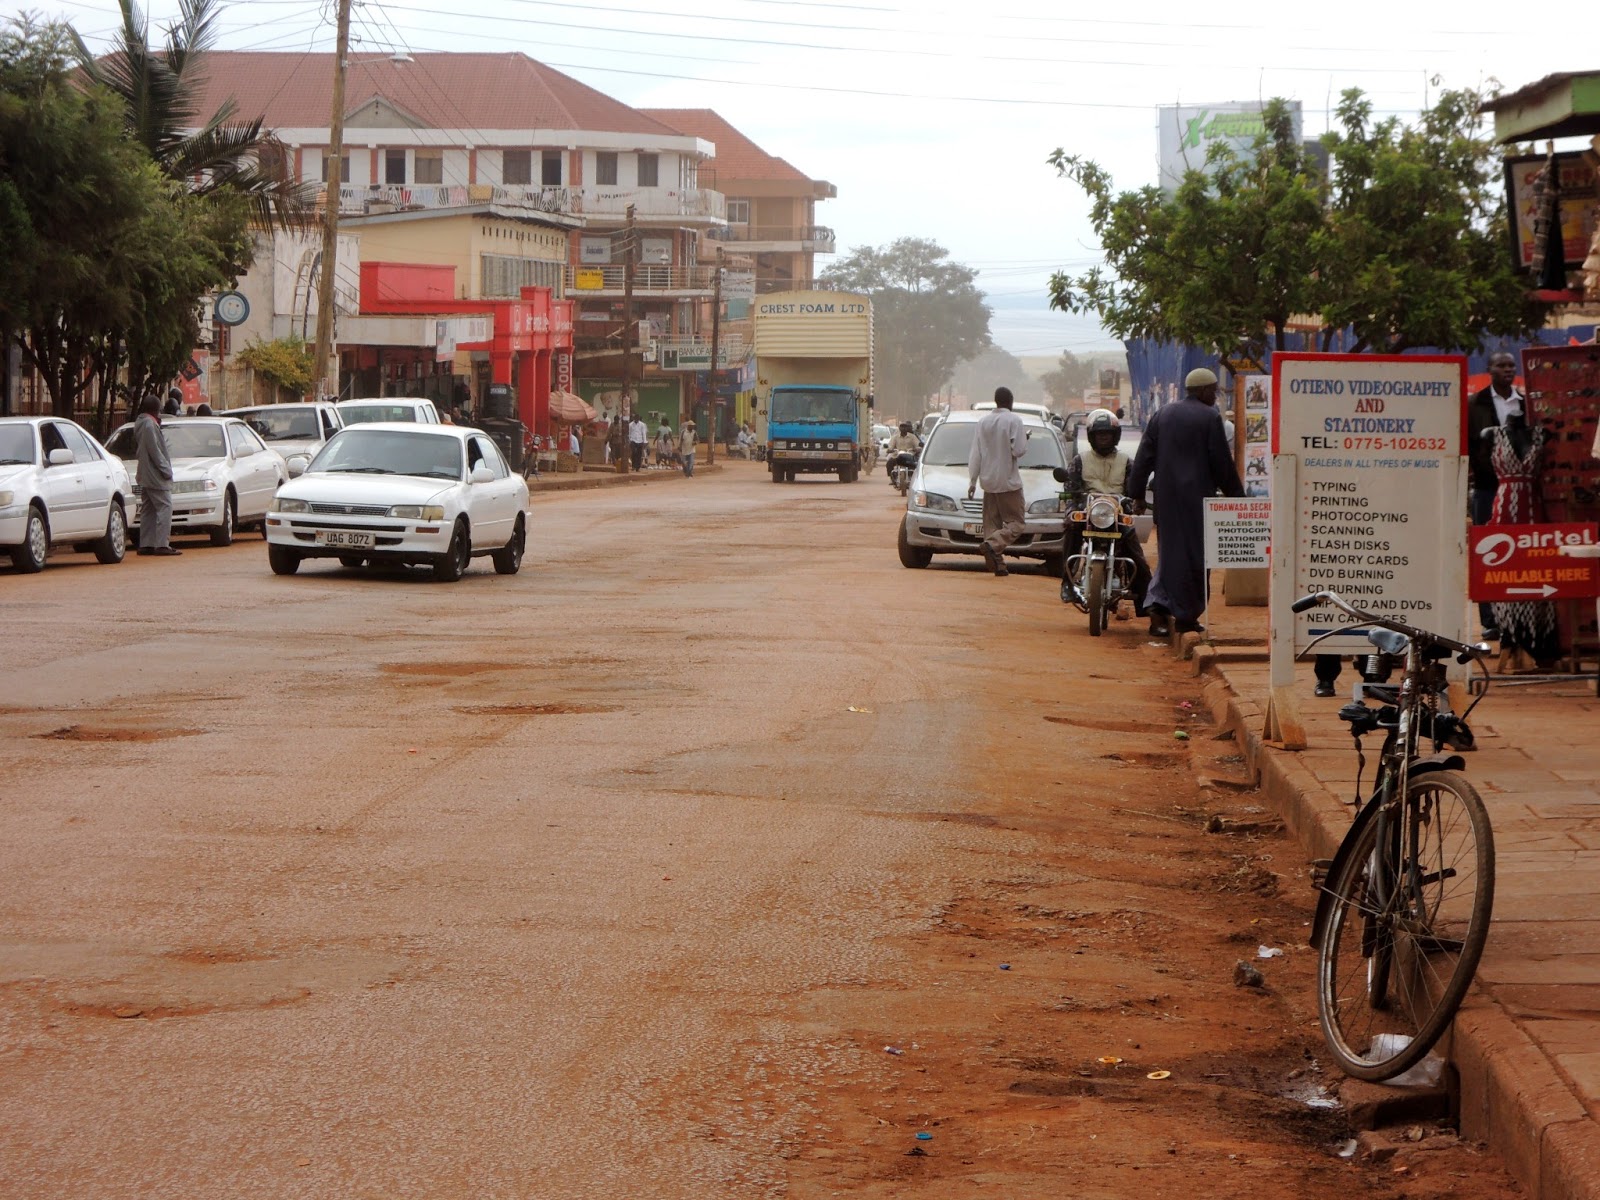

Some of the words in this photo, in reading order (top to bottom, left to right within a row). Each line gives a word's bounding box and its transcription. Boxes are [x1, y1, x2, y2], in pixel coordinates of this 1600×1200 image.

[760, 304, 796, 314] CREST
[799, 303, 835, 313] FOAM
[841, 304, 865, 313] LTD
[678, 347, 694, 356] BANK
[695, 347, 704, 355] OF
[1290, 379, 1344, 395] OTIENO
[1348, 380, 1452, 397] VIDEOGRAPHY
[1355, 398, 1385, 413] AND
[1324, 418, 1416, 434] STATIONERY
[1301, 436, 1338, 449] TEL:
[1343, 437, 1446, 450] 0775-102632
[1304, 458, 1342, 467] DEALERS
[1344, 458, 1352, 467] IN
[1356, 459, 1370, 468] ALL
[1374, 459, 1398, 468] TYPES
[1401, 460, 1412, 468] OF
[1414, 460, 1440, 469] MUSIC
[1312, 481, 1357, 492] TYPING
[1209, 503, 1248, 511] TOHAWASA
[1312, 496, 1369, 507] PRINTING
[1311, 511, 1409, 523] PHOTOCOPYING
[1311, 525, 1375, 536] SCANNING
[326, 533, 344, 543] UAG
[348, 534, 370, 545] 807Z
[1517, 528, 1593, 548] airtel
[1310, 539, 1350, 550] FLASH
[1354, 540, 1390, 551] DISKS
[1310, 554, 1363, 565] MEMORY
[1367, 555, 1409, 566] CARDS
[1309, 568, 1334, 578] DVD
[1338, 569, 1394, 580] BURNING
[1484, 569, 1553, 585] AVAILABLE
[1556, 568, 1590, 582] HERE
[1307, 584, 1325, 594] CD
[1328, 585, 1383, 595] BURNING
[1351, 600, 1368, 609] CD
[1372, 600, 1397, 610] AND
[1401, 600, 1432, 611] DVDs
[1307, 613, 1334, 623] NEW
